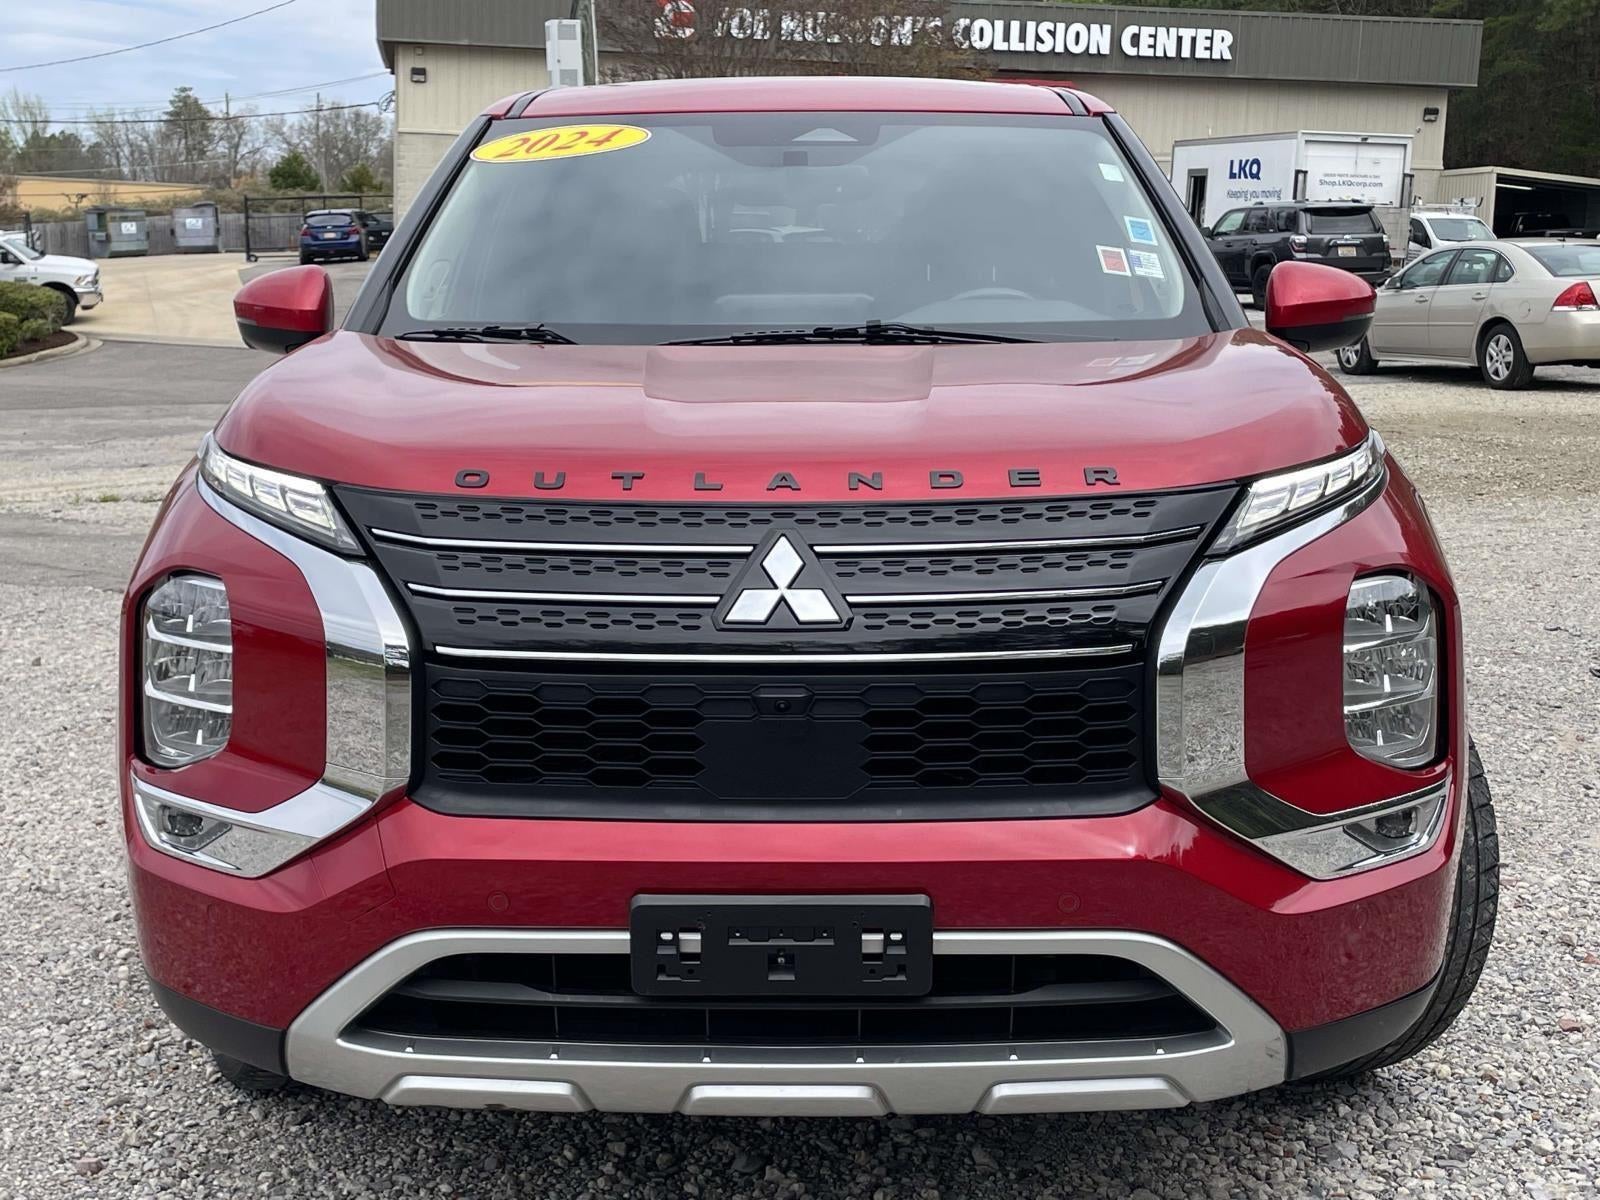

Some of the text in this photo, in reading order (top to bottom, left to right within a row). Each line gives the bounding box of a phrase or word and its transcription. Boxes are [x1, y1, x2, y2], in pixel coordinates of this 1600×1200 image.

[952, 18, 1111, 55] COLLISION
[1120, 25, 1234, 60] CENTER
[494, 128, 625, 158] 2024
[1229, 158, 1261, 181] LKQ
[1227, 187, 1281, 201] Keeping you moving
[1319, 179, 1383, 188] Shop.LKQcorp.com
[454, 466, 1120, 491] OUTLANDER
